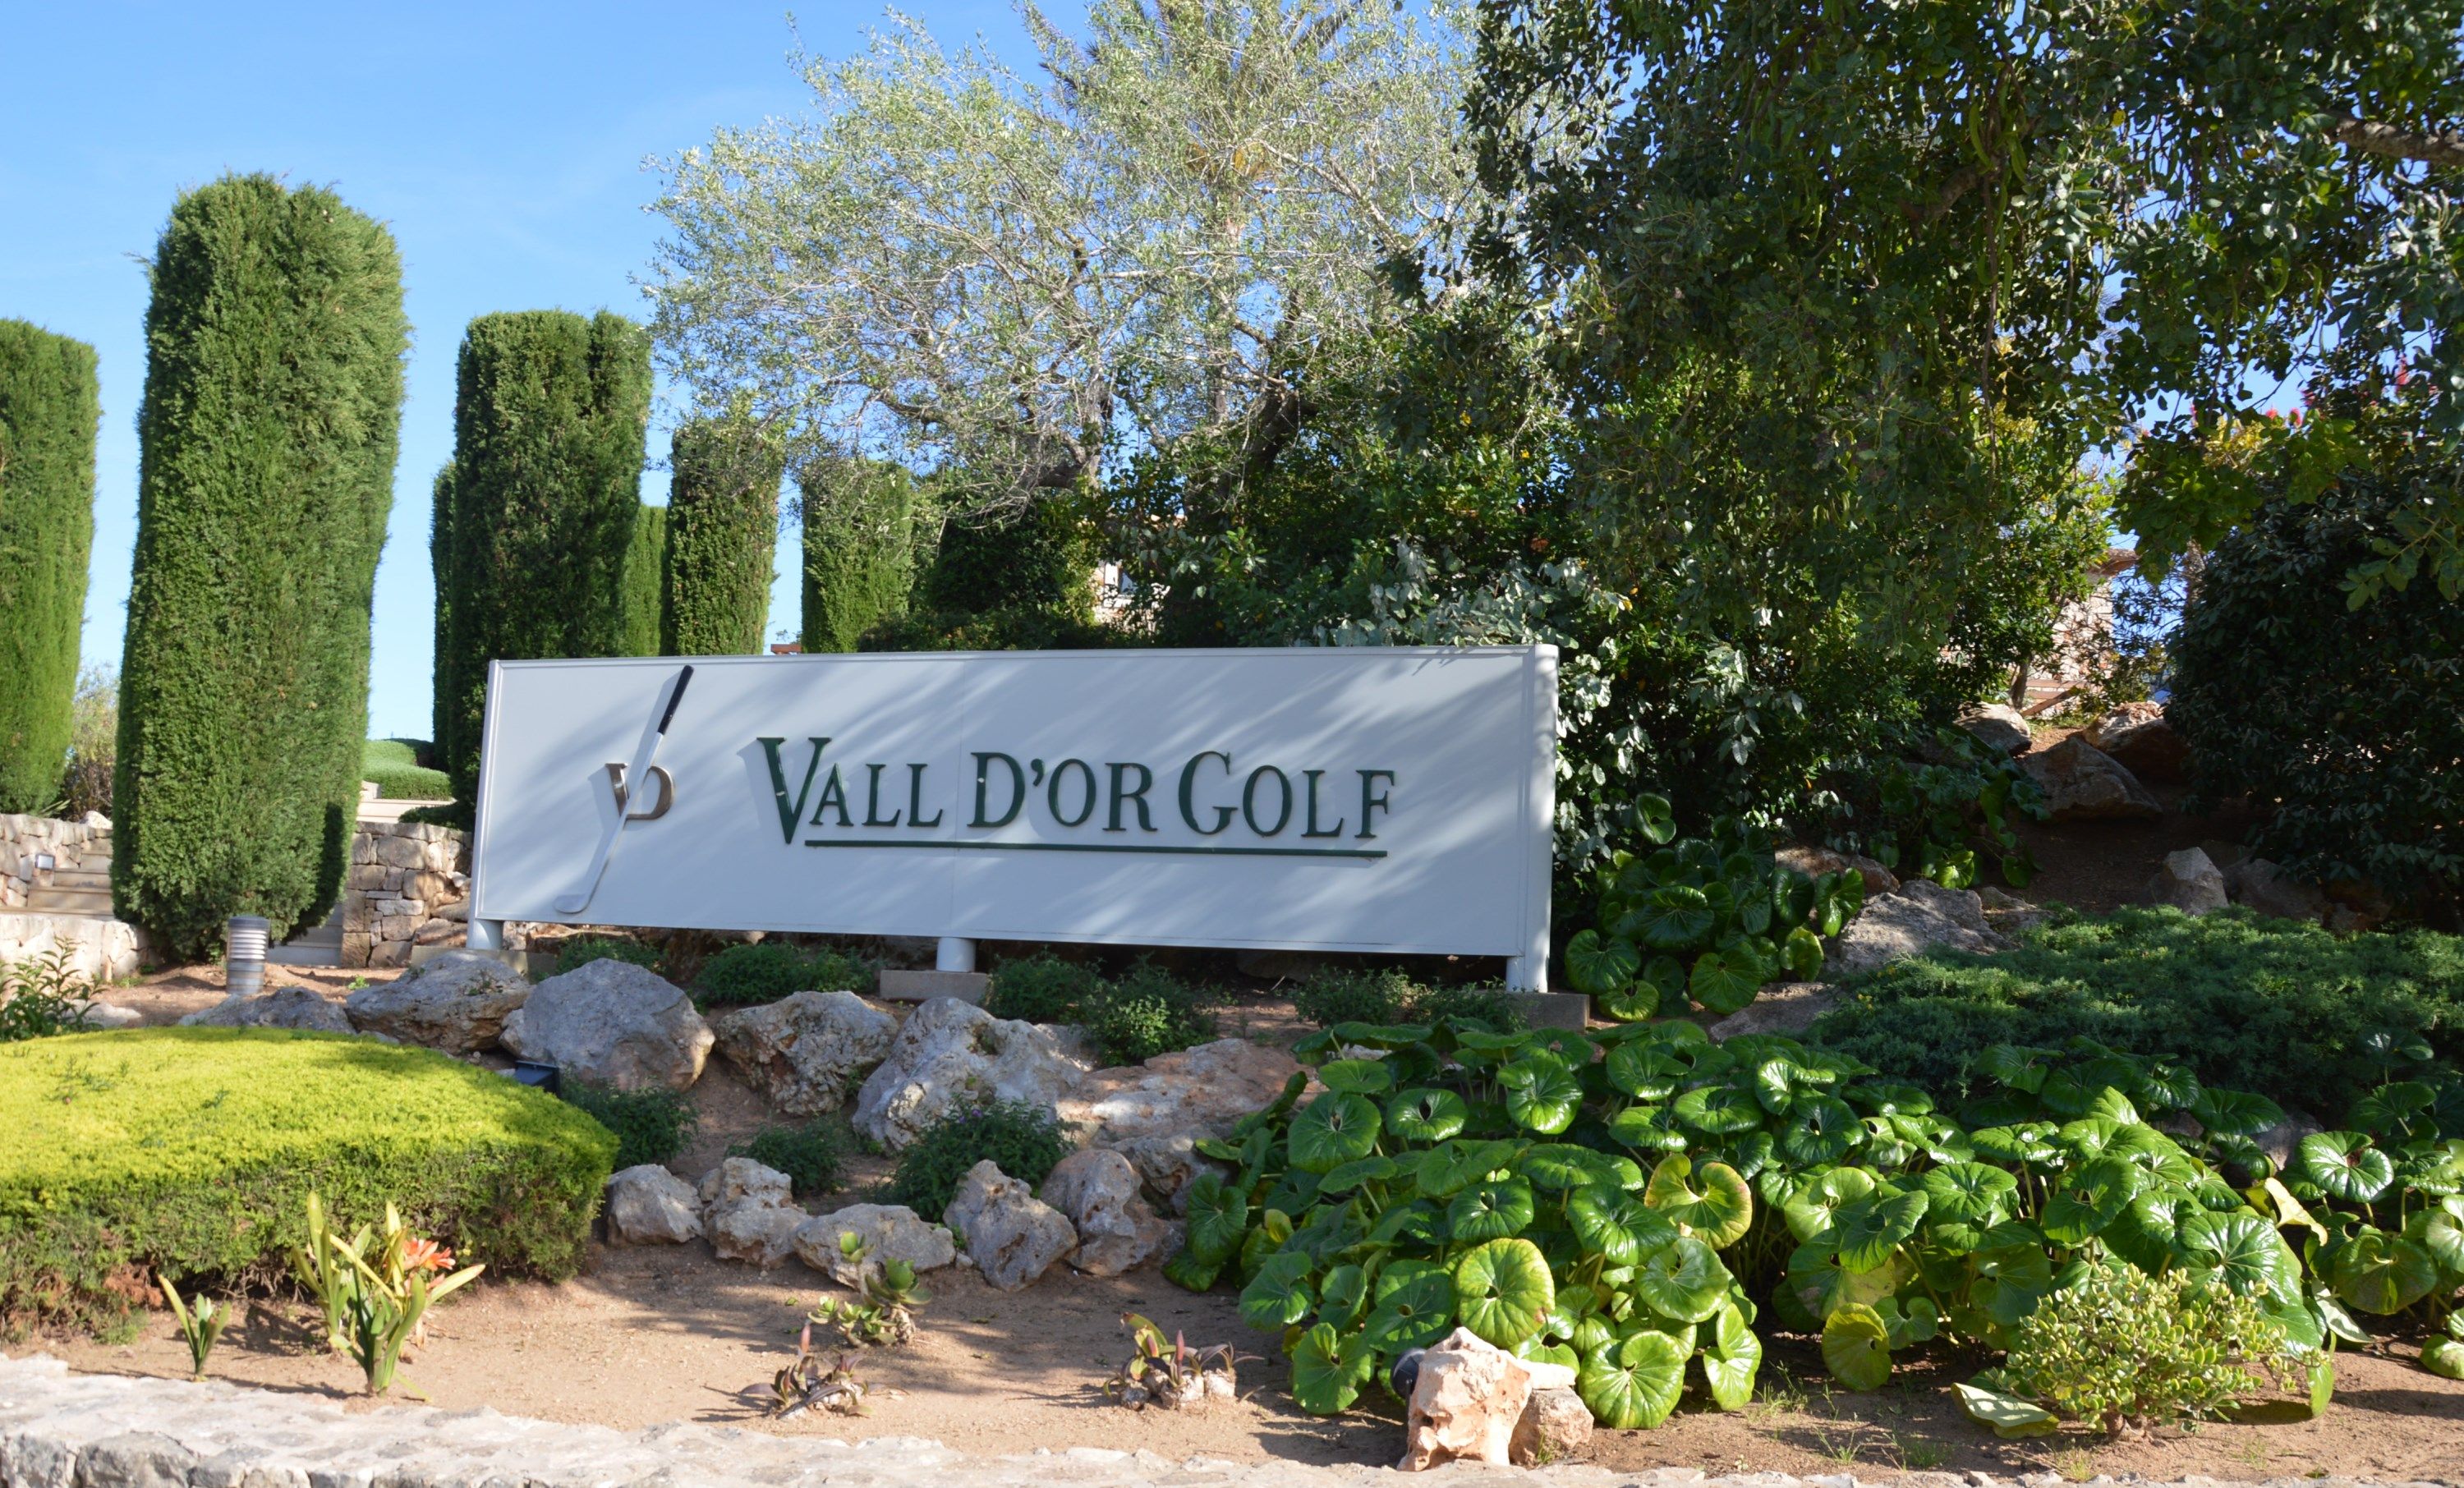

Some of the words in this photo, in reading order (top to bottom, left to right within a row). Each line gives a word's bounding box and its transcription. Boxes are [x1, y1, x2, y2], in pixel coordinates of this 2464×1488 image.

[756, 737, 943, 844] VALL
[967, 751, 1158, 832] D'OR
[1178, 751, 1395, 838] GOLF
